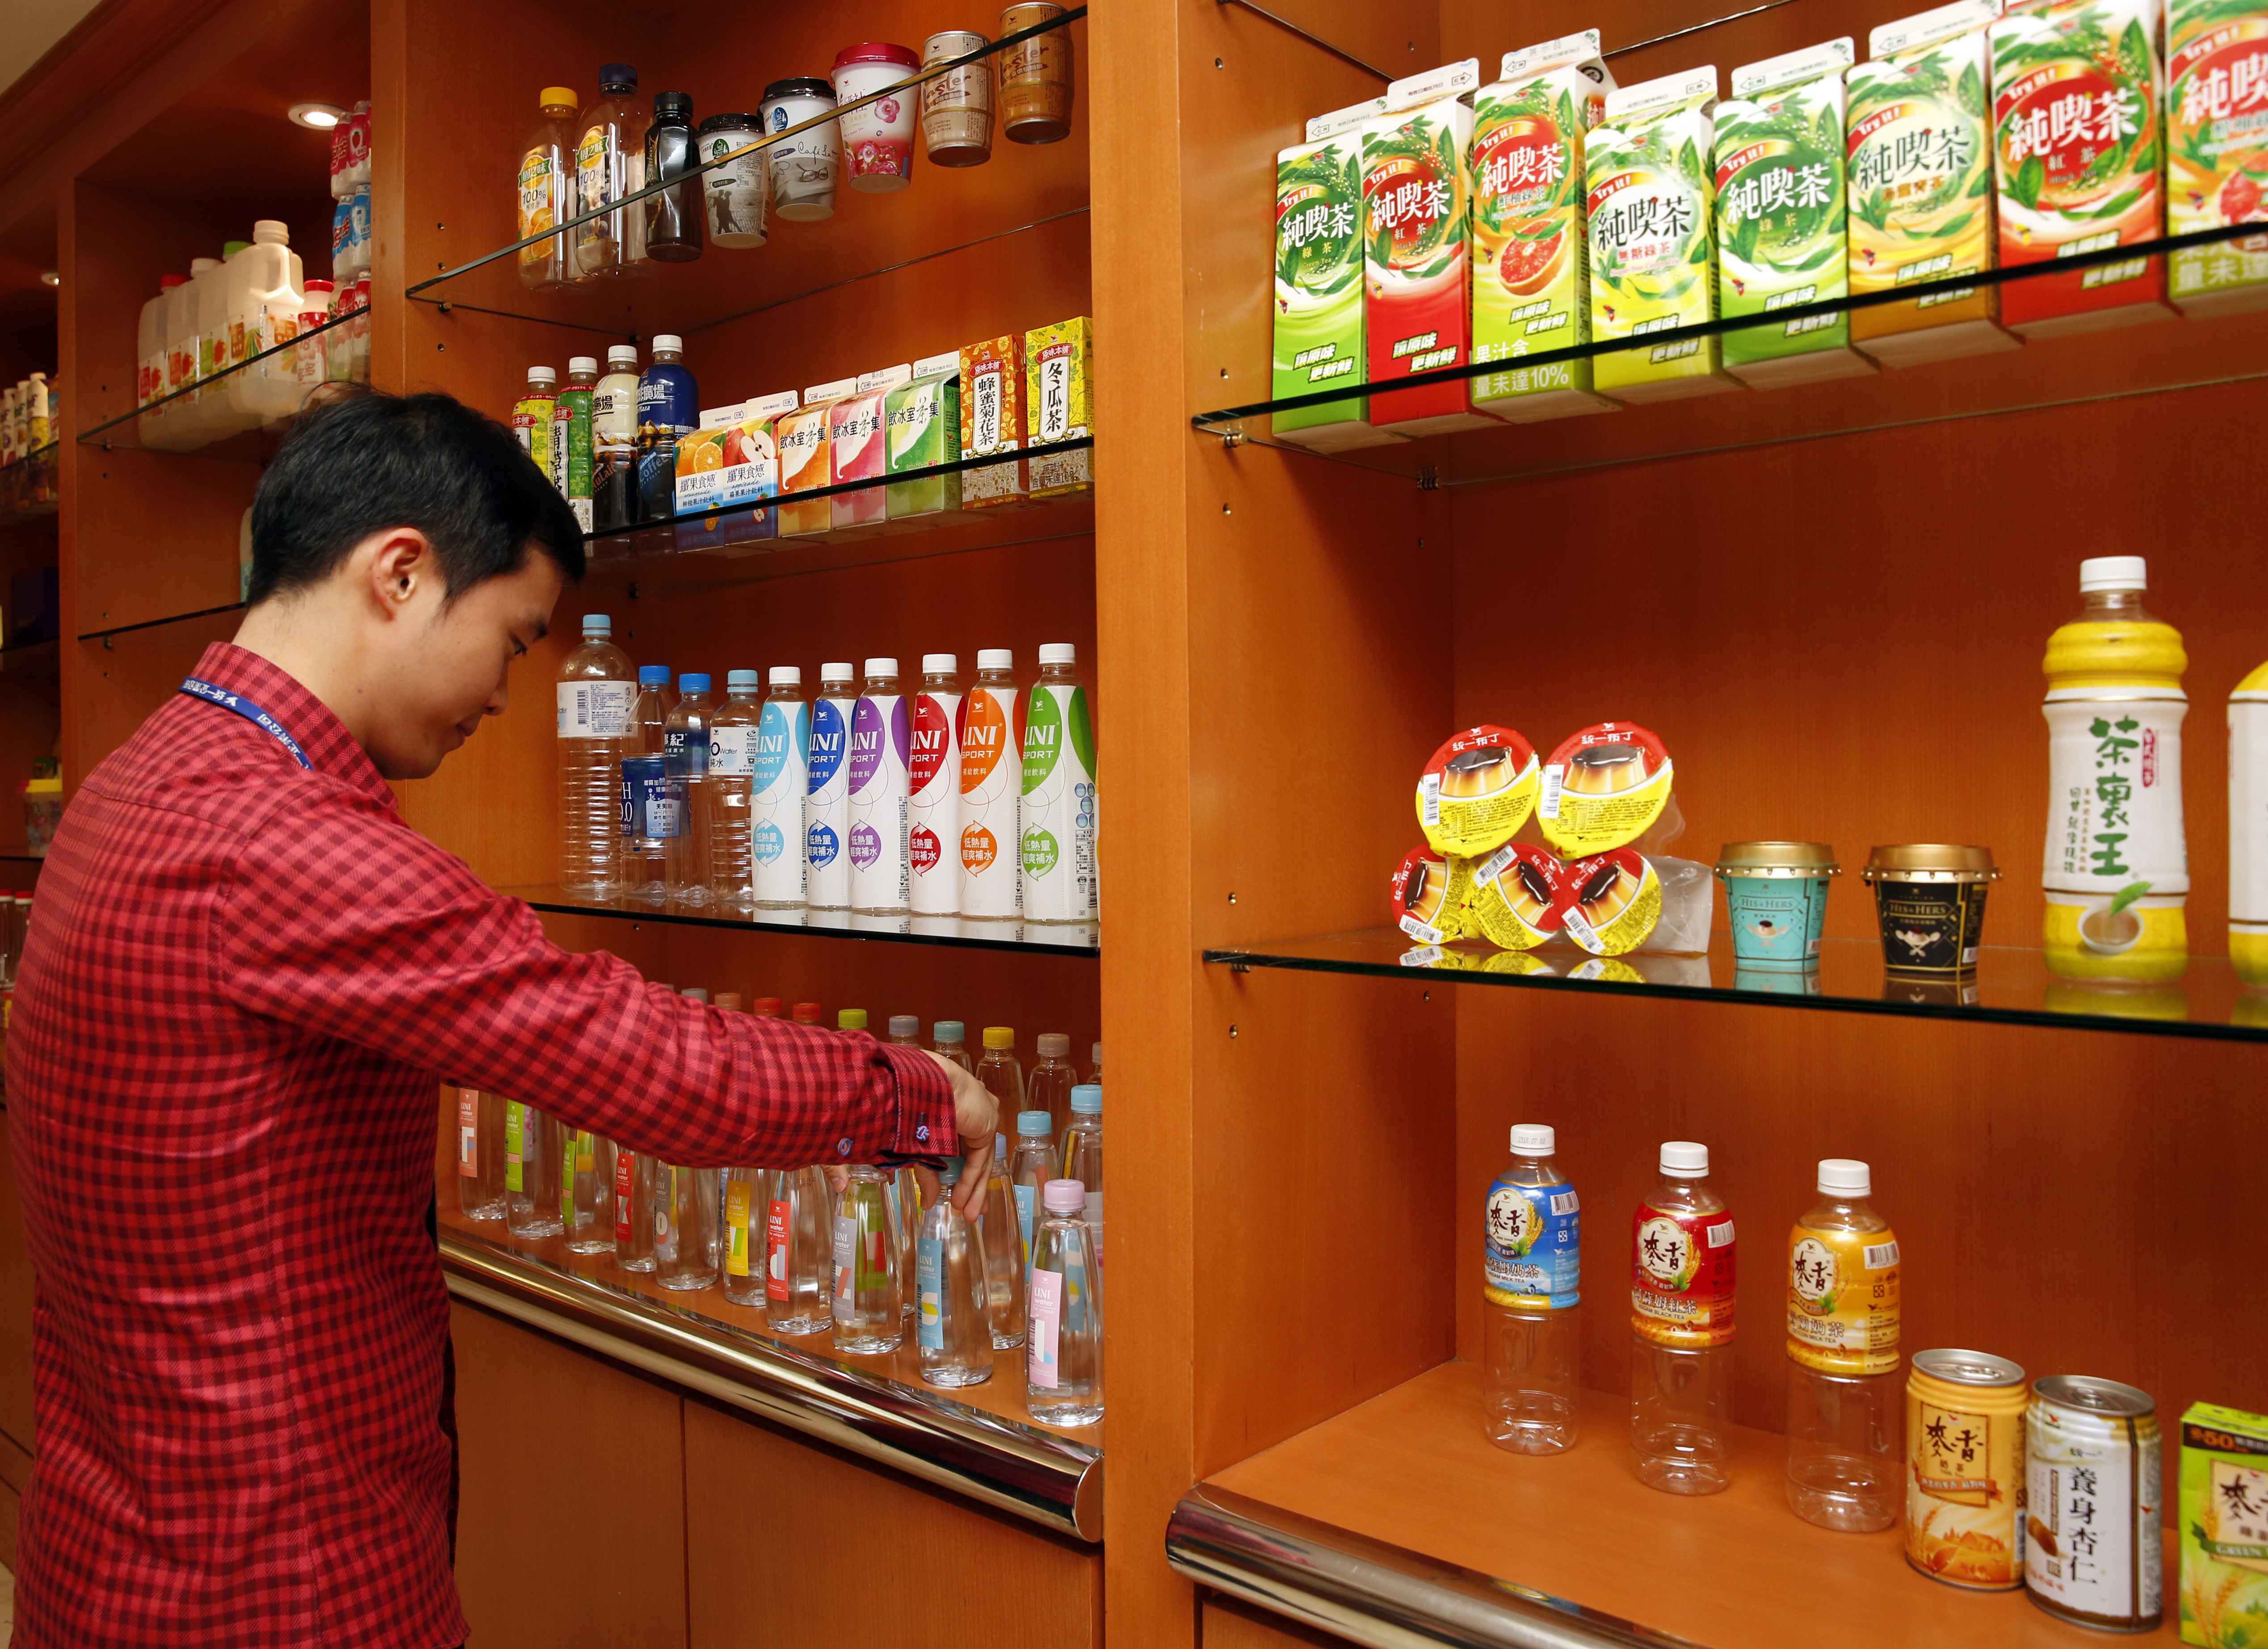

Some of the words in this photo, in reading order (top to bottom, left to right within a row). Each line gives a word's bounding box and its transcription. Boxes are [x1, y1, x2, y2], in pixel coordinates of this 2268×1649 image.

[2007, 81, 2032, 99] Try
[2033, 69, 2055, 84] it!
[1858, 118, 1880, 135] Try
[1881, 107, 1901, 122] it!
[2008, 87, 2140, 161] 純喫茶
[1482, 134, 1499, 149] Try
[1499, 126, 1513, 139] it!
[1726, 154, 1745, 170] Try
[1747, 145, 1764, 161] it!
[1859, 126, 1972, 190] 純喫茶
[580, 170, 604, 185] 100%
[1369, 170, 1387, 185] Try
[1388, 160, 1403, 176] it!
[1481, 143, 1565, 198] 純喫茶
[522, 189, 546, 204] 100%
[1283, 194, 1298, 207] Try
[1299, 187, 1313, 200] it!
[1595, 185, 1613, 200] Try
[1613, 175, 1630, 192] it!
[1726, 164, 1831, 224] 純喫茶
[1371, 180, 1451, 232] 純喫茶
[1281, 202, 1355, 251] 純喫茶
[1598, 196, 1691, 251] 純喫茶
[1525, 312, 1568, 335] 更新鮮
[1411, 346, 1457, 372] 更新鮮
[1309, 357, 1353, 382] 更新鮮
[1475, 365, 1569, 398] 量未達10%
[1045, 362, 1063, 433] 冬瓜茶
[888, 396, 938, 426] 飲冰室茶集
[978, 377, 996, 446] 蜂蜜菊花茶
[833, 410, 880, 439] 飲冰室茶集
[780, 422, 826, 449] 飲冰室茶集
[680, 474, 716, 493] 纖果食感
[727, 463, 764, 484] 纖果食感
[757, 735, 783, 753] UNI
[808, 733, 839, 753] UNI
[852, 731, 878, 751] UNI
[910, 730, 943, 749] UNI
[964, 725, 998, 745] UNI
[1025, 724, 1054, 746] UNI
[1452, 733, 1499, 751] 統一布丁
[1582, 731, 1634, 745] 統一布丁
[850, 754, 876, 763] SPORT
[909, 754, 939, 762] SPORT
[962, 750, 995, 759] SPORT
[1023, 750, 1054, 759] SPORT
[2089, 715, 2139, 875] 茶裏王
[756, 833, 777, 843] 低熱量
[809, 834, 832, 845] 低熱量
[852, 834, 874, 846] 低熱量
[911, 837, 933, 850] 低熱量
[964, 837, 989, 849] 低熱量
[1024, 839, 1051, 851] 低熱量
[755, 844, 781, 854] 輕爽補水
[808, 845, 836, 856] 輕爽補水
[850, 845, 878, 857] 輕爽補水
[910, 850, 937, 862] 輕爽補水
[962, 850, 993, 862] 輕爽補水
[1023, 851, 1055, 865] 輕爽補水
[617, 1166, 627, 1175] UNI
[729, 1195, 742, 1204] UNI
[770, 1215, 782, 1225] UNI
[1491, 1200, 1527, 1237] 麥香
[835, 1231, 848, 1242] UNI
[920, 1254, 932, 1265] UNI
[1643, 1231, 1685, 1270] 麥香
[1795, 1251, 1832, 1291] 麥香
[1034, 1287, 1052, 1299] UNI
[1034, 1298, 1053, 1307] water
[1654, 1309, 1672, 1318] BLACK
[1926, 1415, 1984, 1462] 麥香
[2069, 1466, 2098, 1585] 養身杏仁
